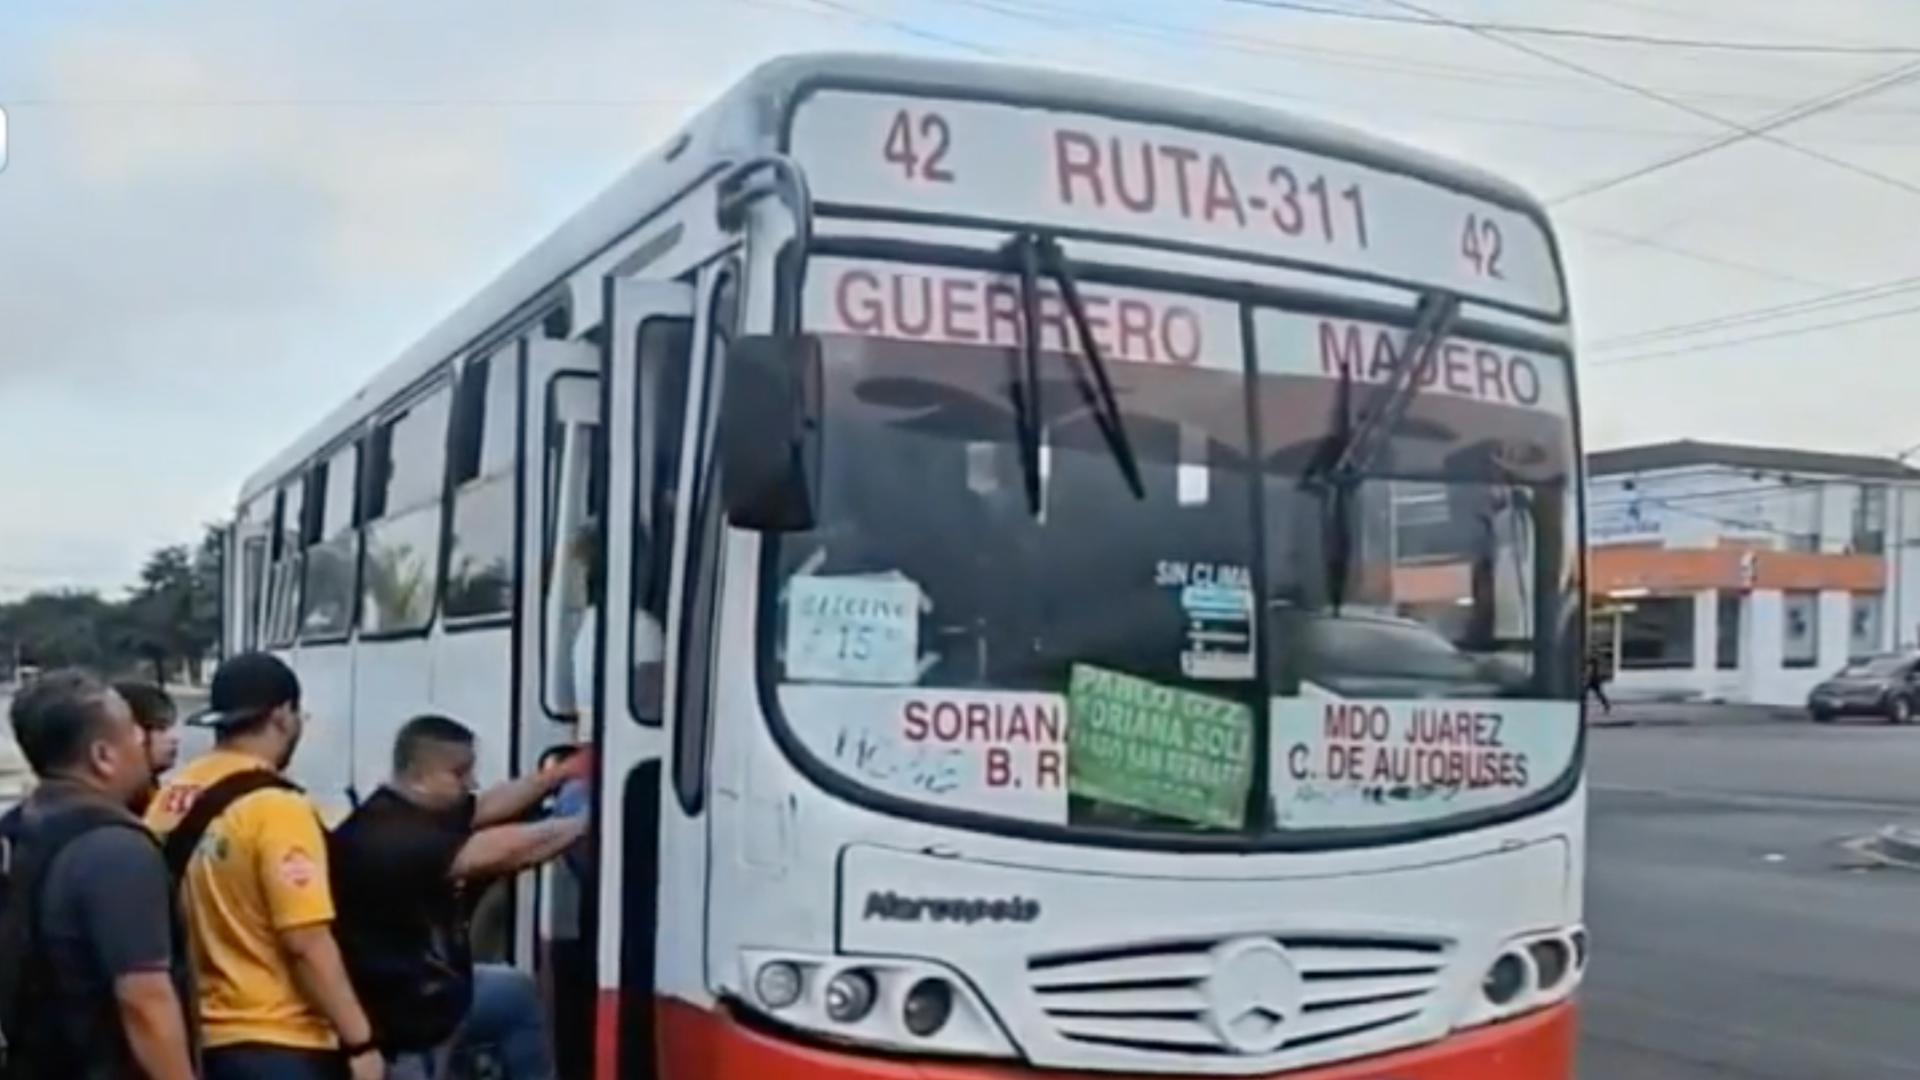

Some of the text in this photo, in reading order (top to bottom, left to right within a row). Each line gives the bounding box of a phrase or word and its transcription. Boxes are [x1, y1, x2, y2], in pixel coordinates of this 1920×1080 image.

[884, 109, 1507, 283] 42 RUTA-311 42
[834, 269, 1204, 366] GUERRERO
[903, 701, 1068, 743] SORIAN
[1324, 703, 1504, 748] MDO JUAREZ
[1288, 743, 1529, 788] C. DE AUTOBUSES
